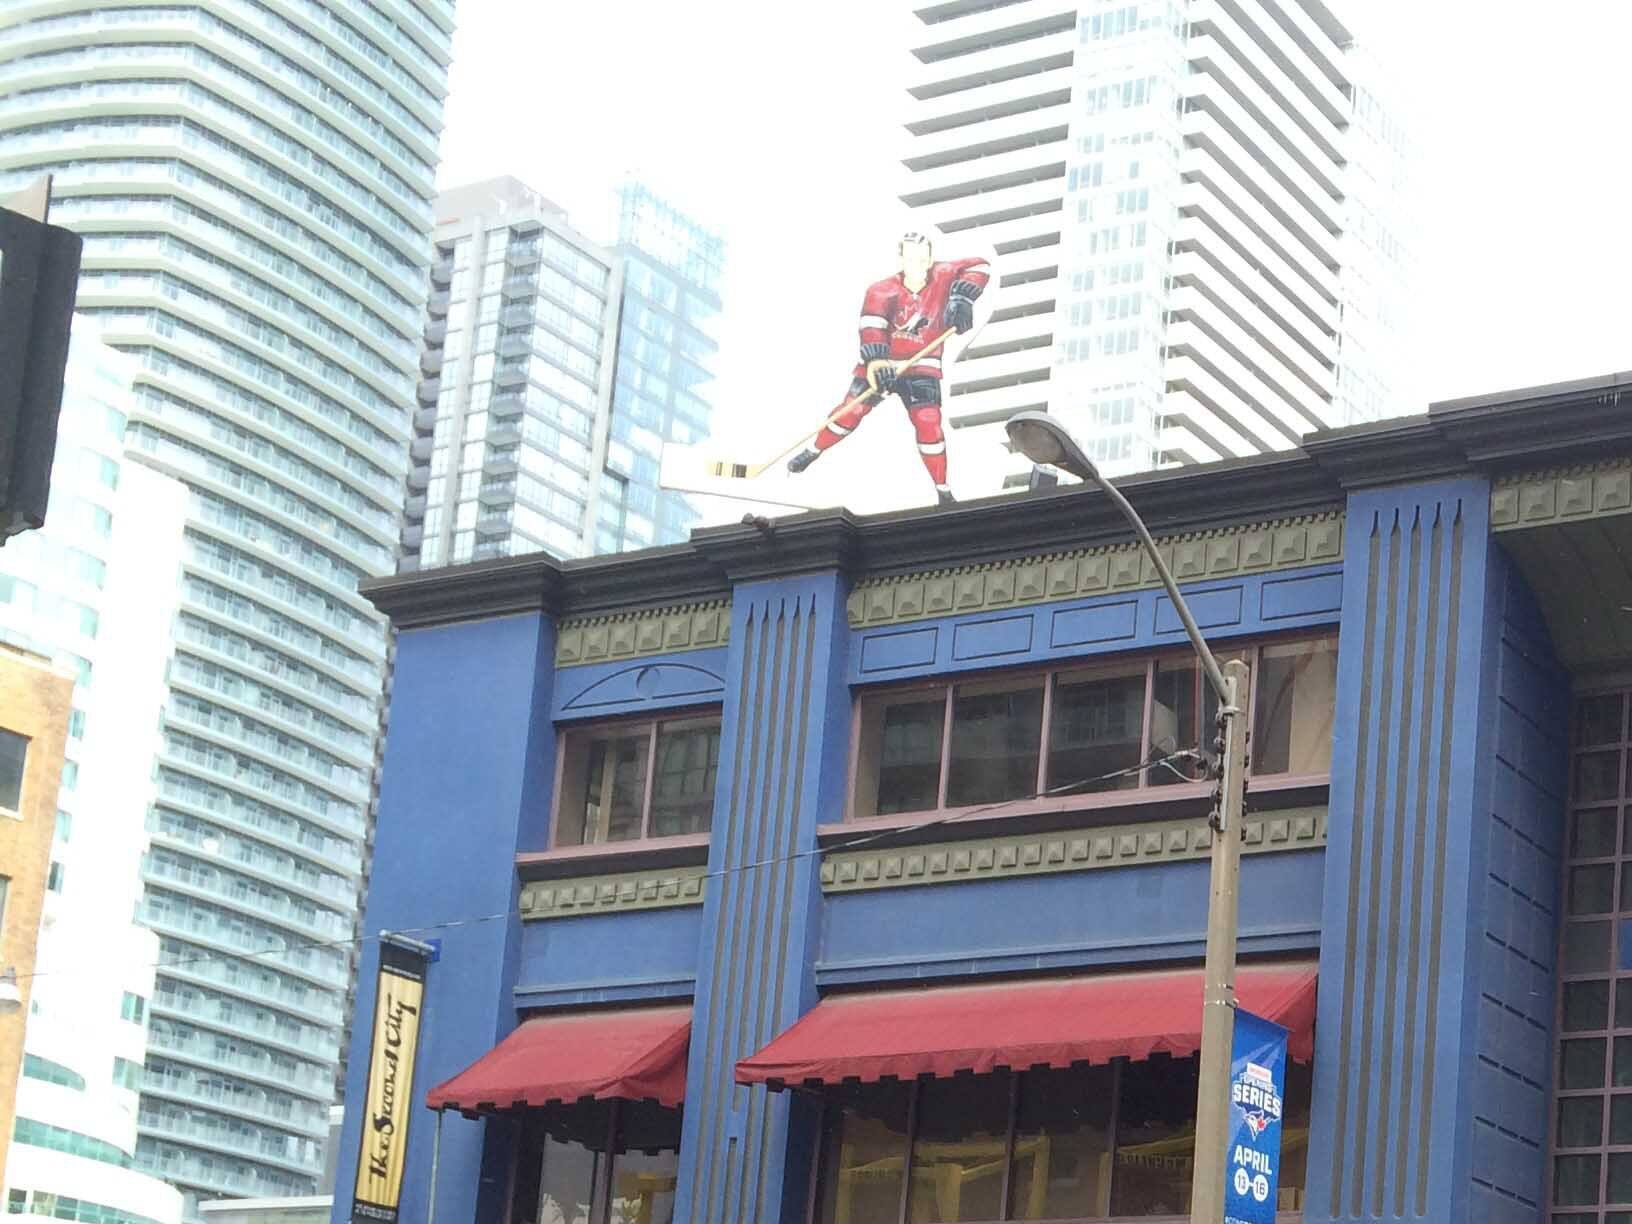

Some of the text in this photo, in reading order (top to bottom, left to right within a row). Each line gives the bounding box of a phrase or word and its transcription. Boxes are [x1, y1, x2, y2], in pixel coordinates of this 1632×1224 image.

[386, 993, 417, 1048] City
[373, 1049, 399, 1134] Second
[1233, 1083, 1281, 1117] SERIES
[368, 1139, 390, 1184] The
[1234, 1145, 1272, 1175] APRIL
